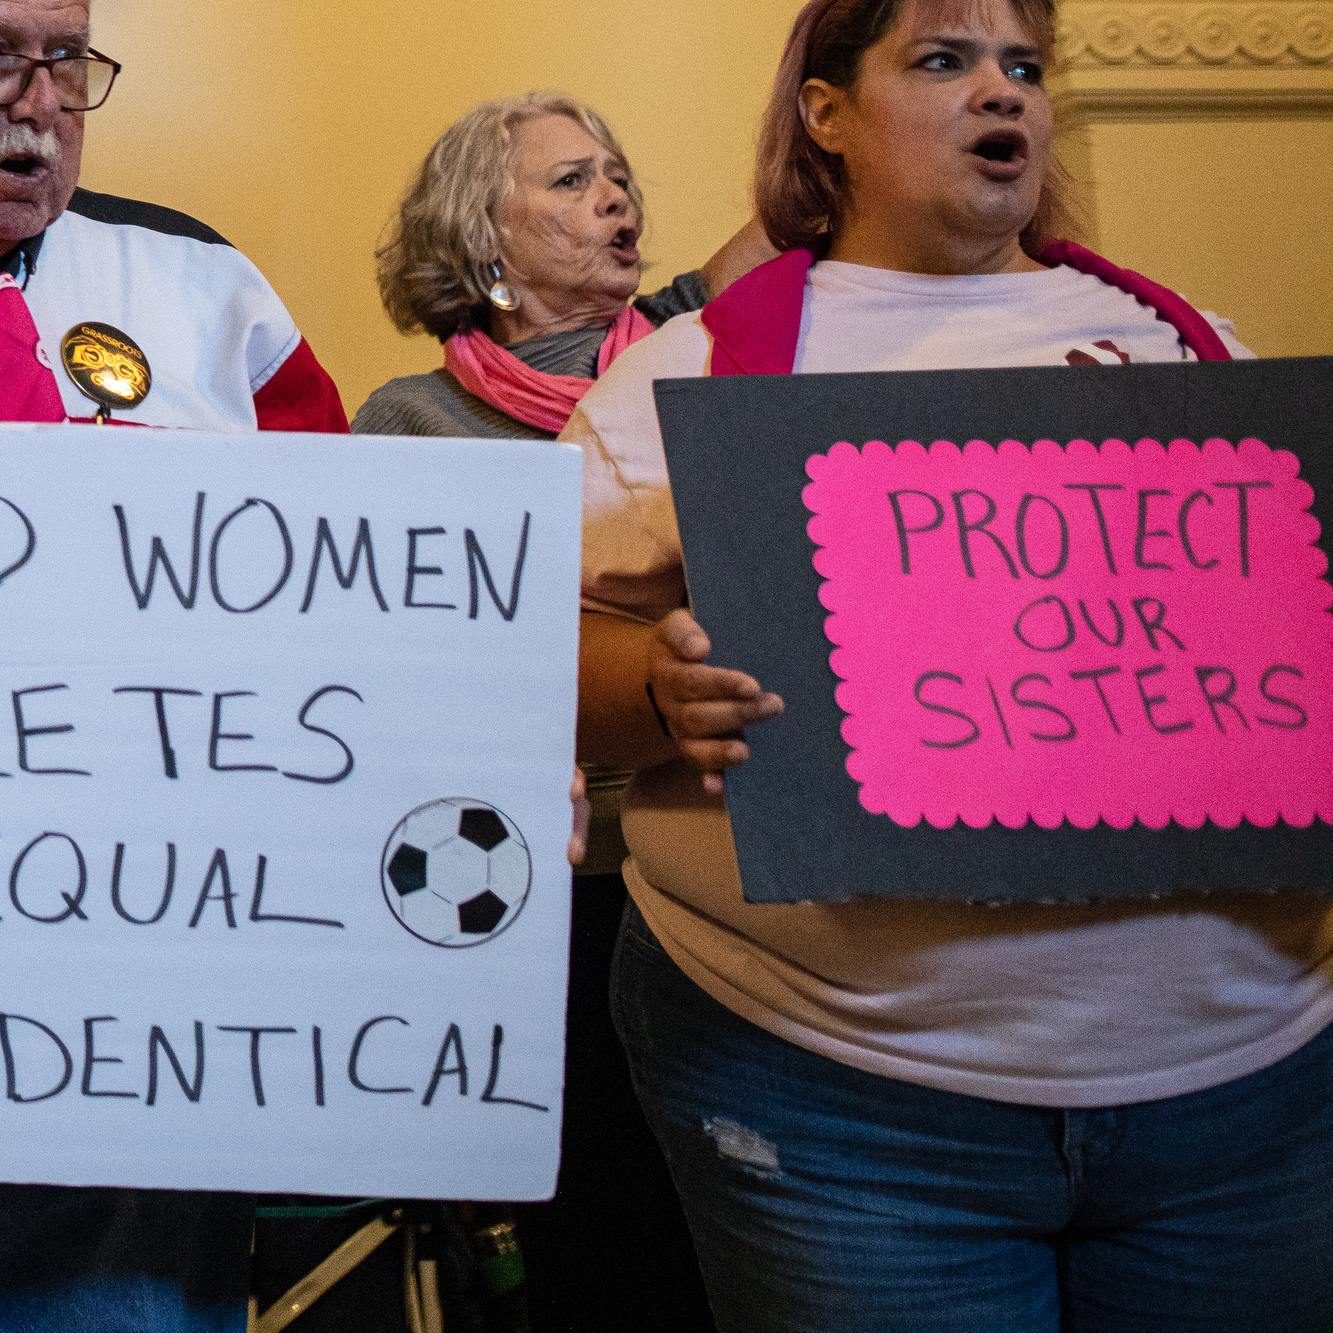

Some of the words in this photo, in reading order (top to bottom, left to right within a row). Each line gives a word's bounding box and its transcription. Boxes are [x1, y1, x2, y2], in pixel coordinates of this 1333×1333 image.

[113, 490, 532, 622] WOMEN
[887, 479, 1275, 581] PROTECT
[1013, 594, 1187, 653] OUR
[913, 662, 1309, 750] SISTERS
